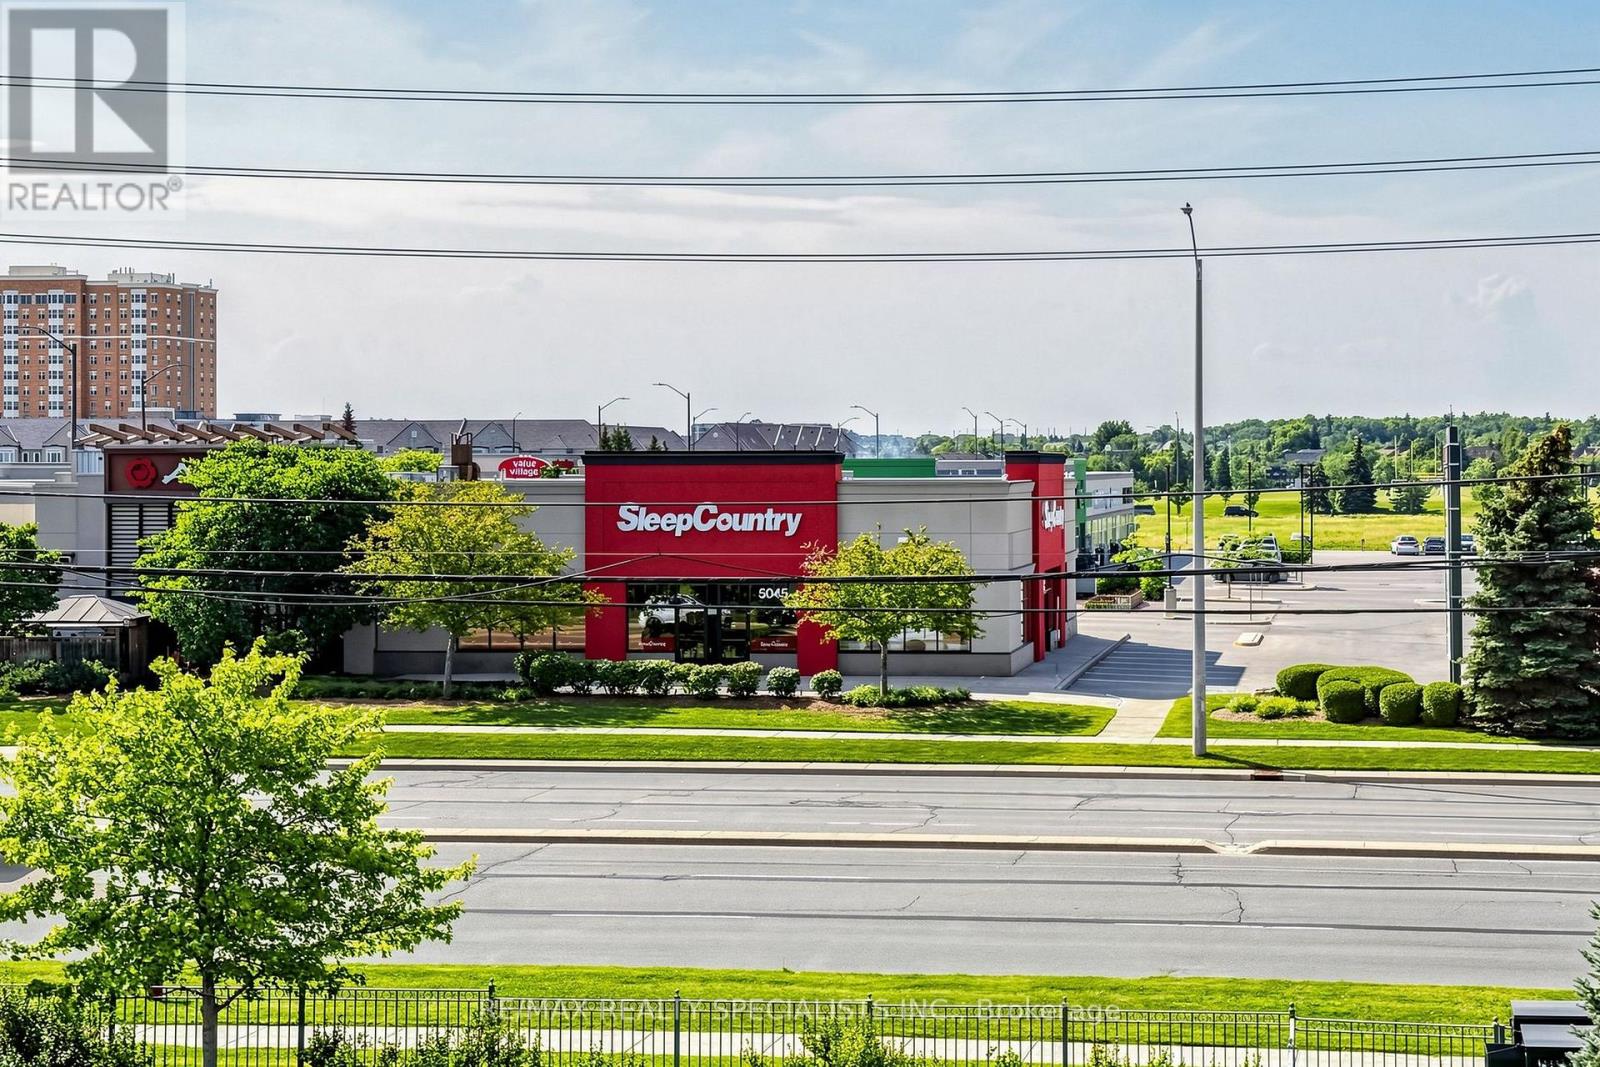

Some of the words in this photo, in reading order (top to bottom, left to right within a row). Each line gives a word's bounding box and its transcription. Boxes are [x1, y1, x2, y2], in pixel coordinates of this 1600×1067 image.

[512, 460, 537, 468] value
[509, 468, 539, 477] village
[616, 502, 802, 537] SleepCountry
[758, 588, 788, 599] 5045
